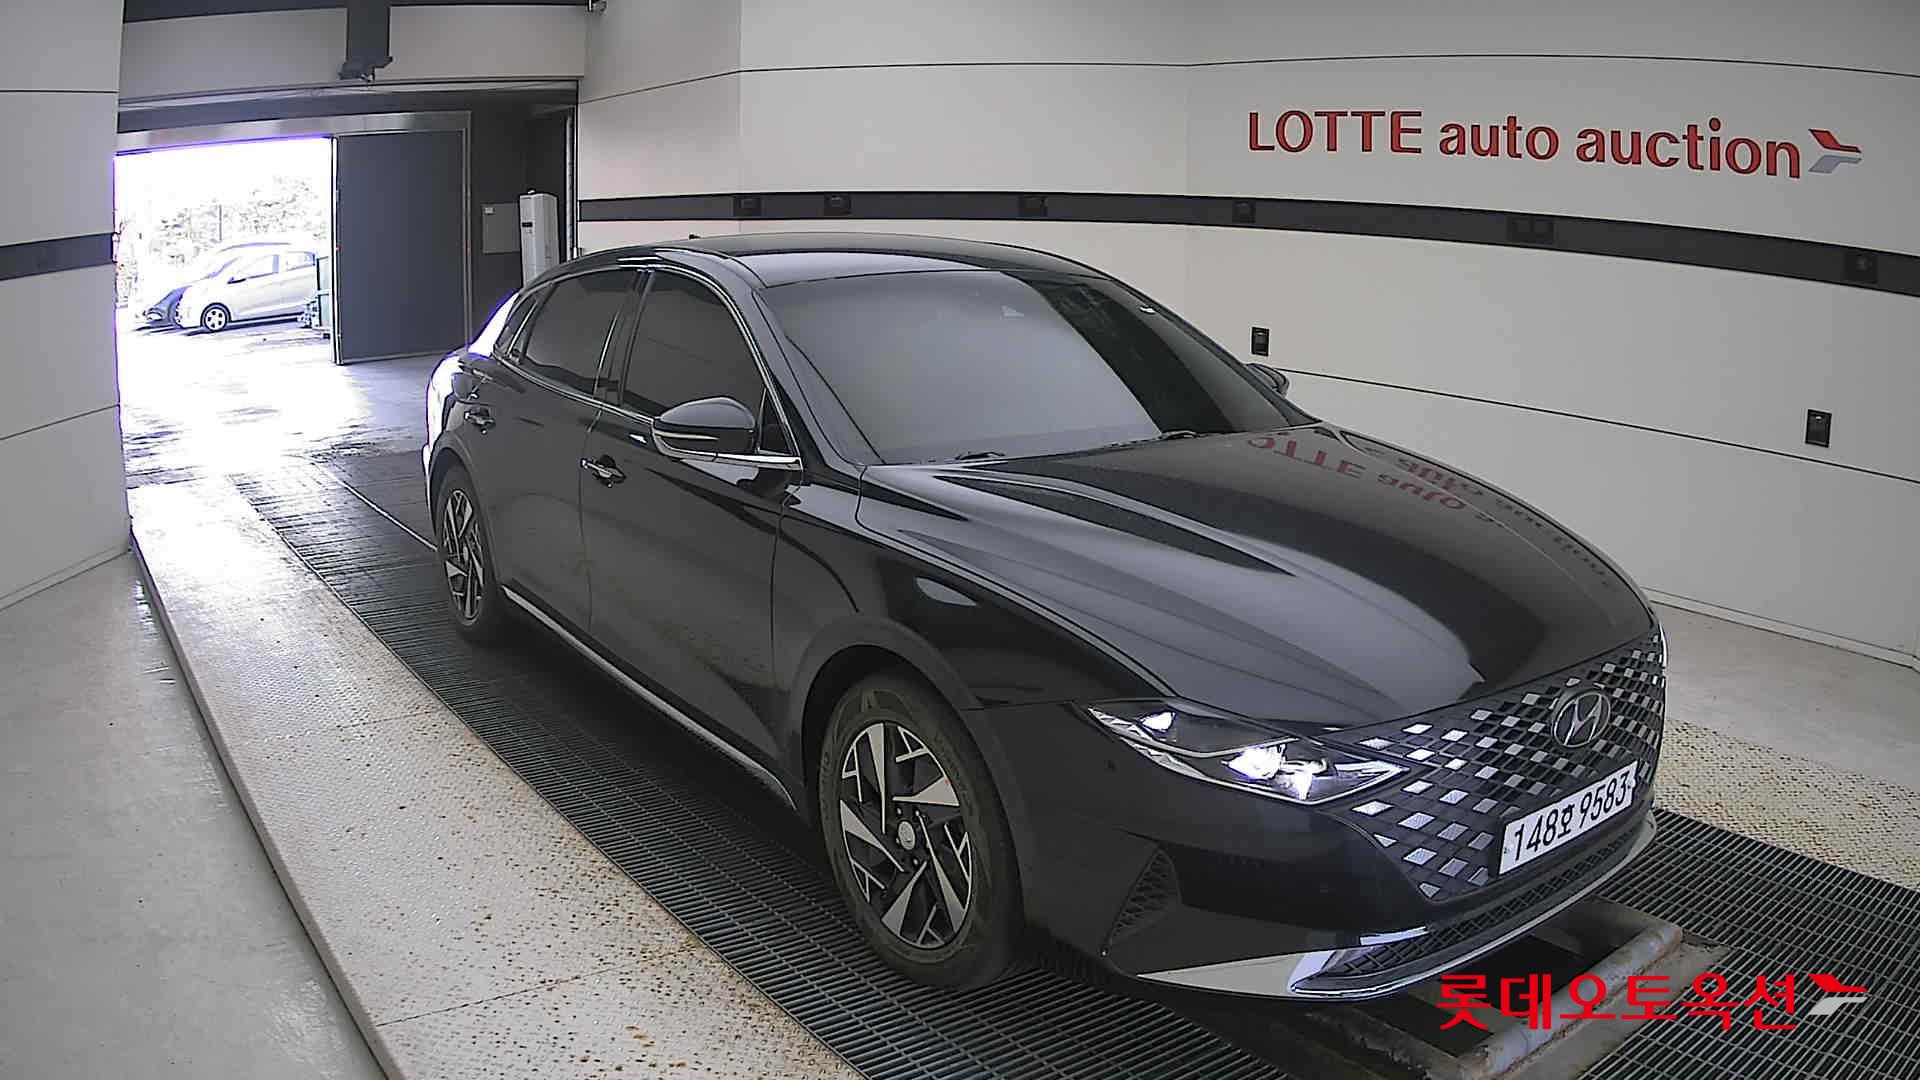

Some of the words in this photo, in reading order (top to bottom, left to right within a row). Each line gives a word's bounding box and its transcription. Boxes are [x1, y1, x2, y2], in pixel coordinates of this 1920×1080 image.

[1249, 111, 1423, 154] LOTTE
[1439, 116, 1560, 160] auto
[1575, 118, 1801, 178] auction
[1579, 771, 1630, 829] 9583
